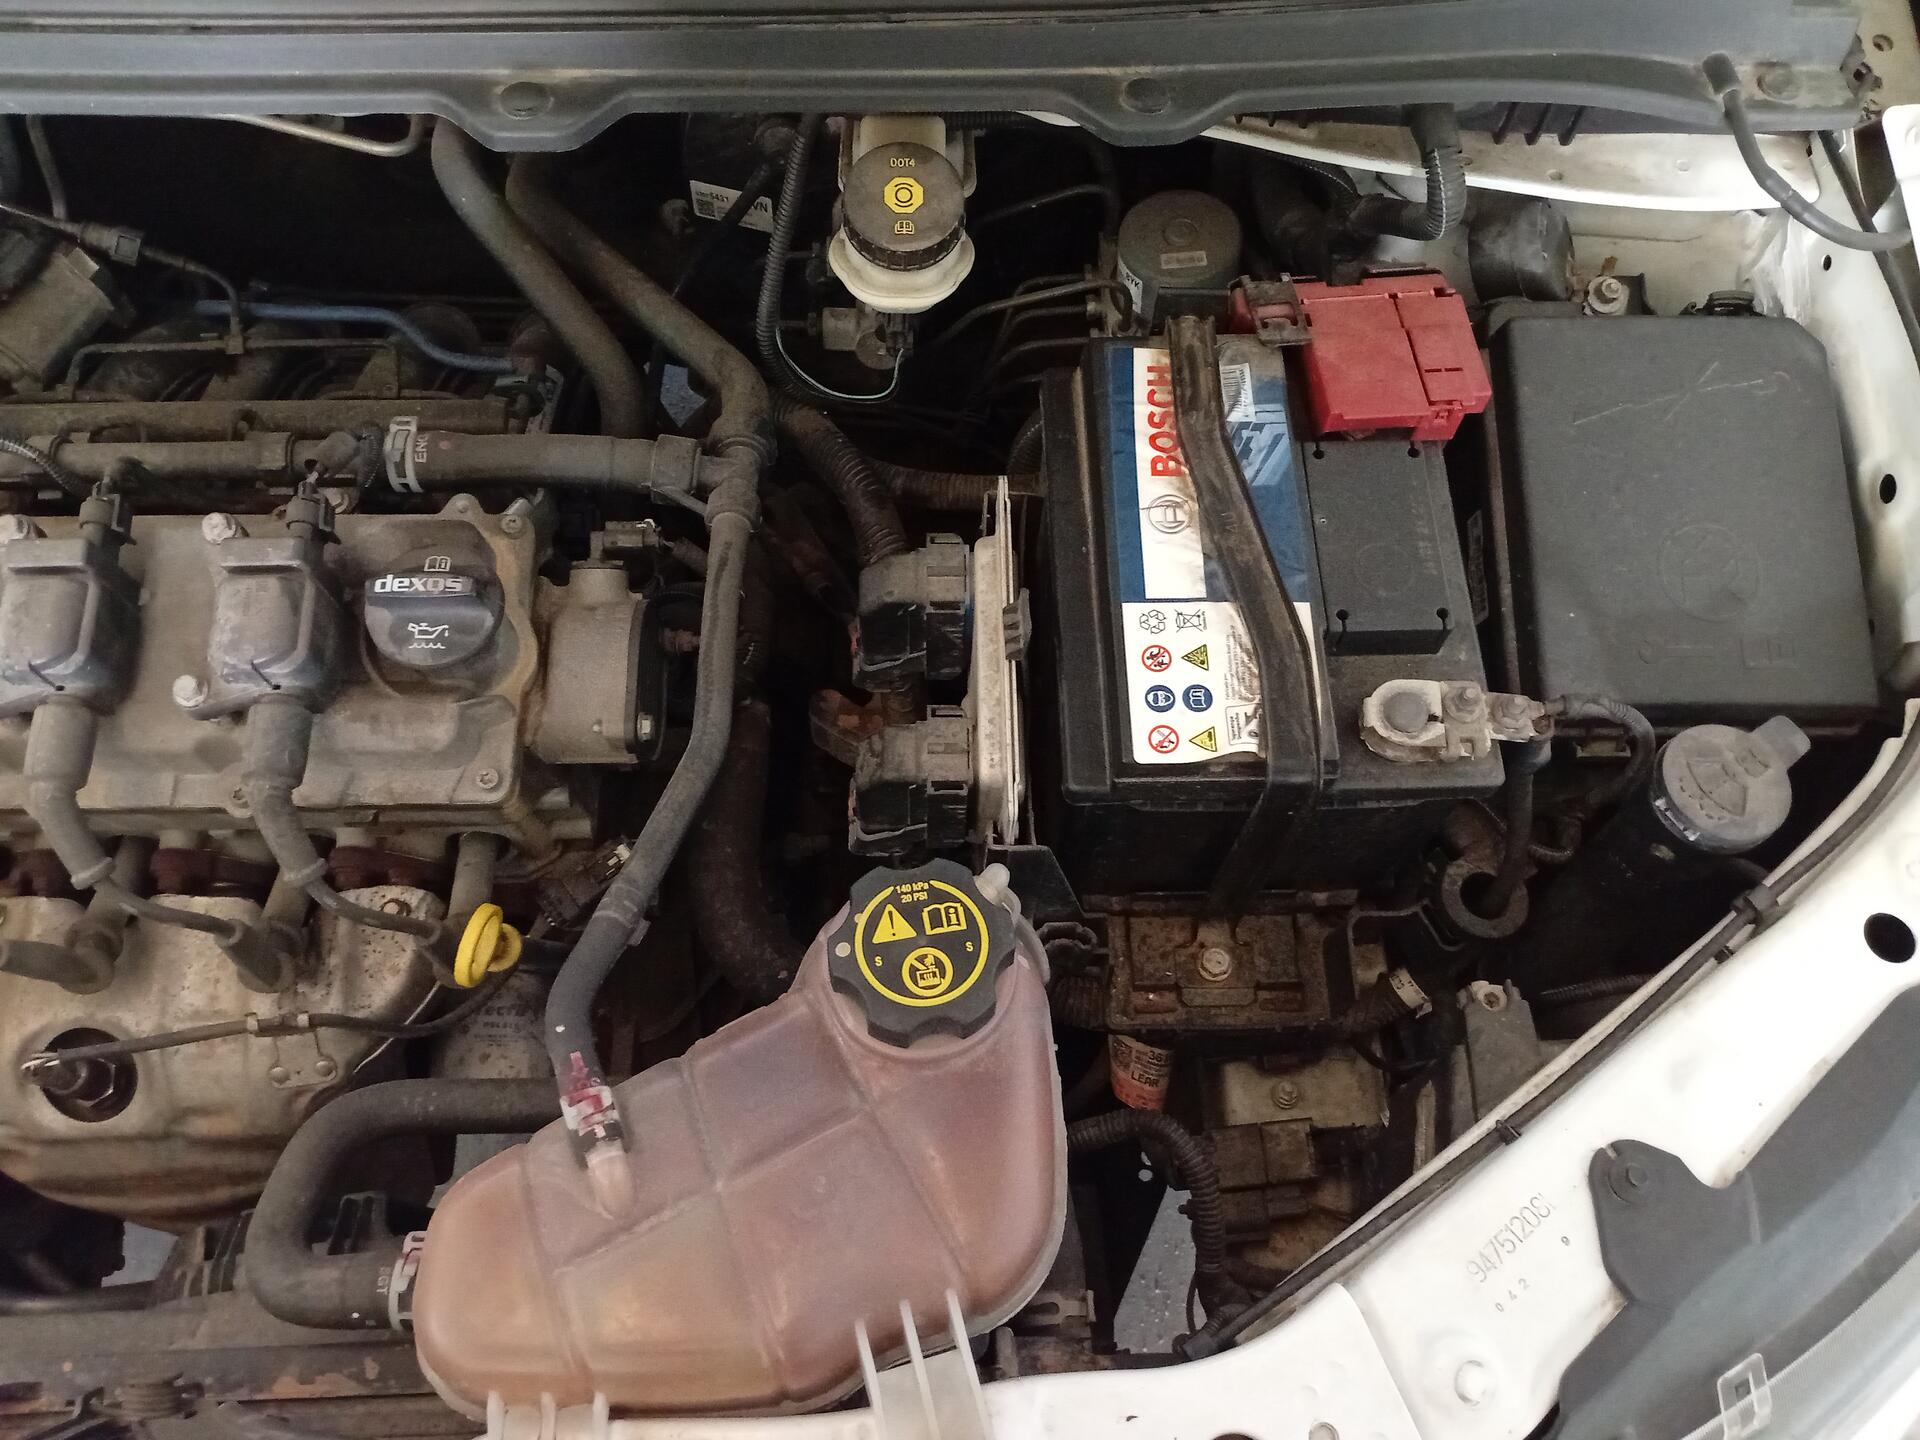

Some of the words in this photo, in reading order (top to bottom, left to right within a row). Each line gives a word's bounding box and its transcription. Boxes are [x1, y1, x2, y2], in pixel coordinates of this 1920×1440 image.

[890, 157, 916, 168] DOT4
[1146, 365, 1185, 477] BOSCH
[374, 574, 463, 593] dexos
[895, 882, 911, 894] 140
[912, 881, 930, 891] kPa
[900, 893, 912, 904] 20
[913, 891, 929, 901] PSI
